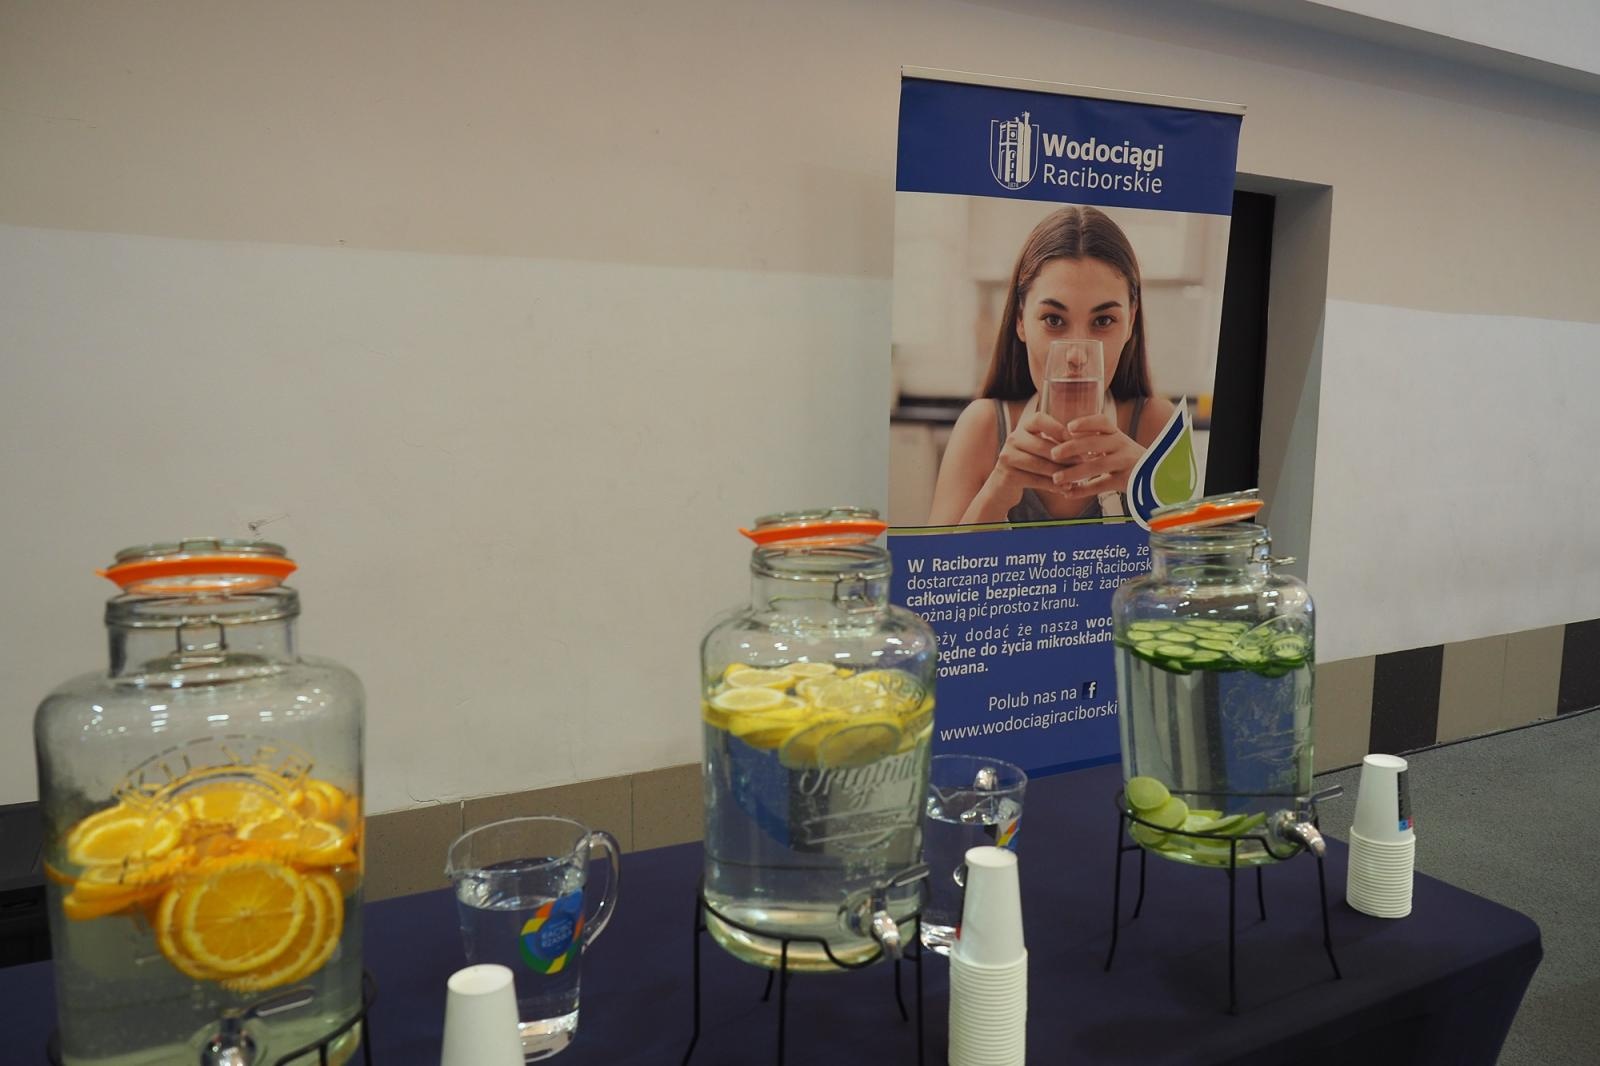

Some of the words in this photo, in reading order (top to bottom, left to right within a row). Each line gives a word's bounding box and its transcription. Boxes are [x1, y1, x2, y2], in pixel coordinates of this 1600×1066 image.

[1042, 132, 1164, 172] Wodociągi
[1043, 163, 1163, 194] Raciborskie
[907, 559, 925, 573] W
[932, 556, 999, 572] Raciborzu
[1005, 551, 1047, 568] mamy
[1053, 549, 1066, 562] to
[1072, 545, 1130, 561] szczęście,
[1136, 544, 1149, 556] że
[907, 570, 988, 590] dostarczana
[992, 568, 1025, 587] przez
[1029, 562, 1093, 580] Wodociągi
[906, 587, 979, 607] całkowicie
[986, 581, 1057, 602] bezpieczna
[1063, 580, 1067, 593] i
[1072, 577, 1094, 592] bez
[915, 607, 953, 623] ożna
[954, 605, 966, 622] ją
[968, 601, 988, 620] pić
[989, 601, 1031, 619] prosto
[1032, 601, 1039, 612] z
[1041, 598, 1079, 611] kranu.
[965, 624, 1010, 643] dodać
[1017, 622, 1033, 636] że
[1041, 619, 1078, 634] nasza
[981, 642, 998, 657] do
[1001, 640, 1033, 656] życia
[989, 692, 1030, 712] Polub
[1033, 689, 1057, 705] nas
[1060, 687, 1077, 701] na
